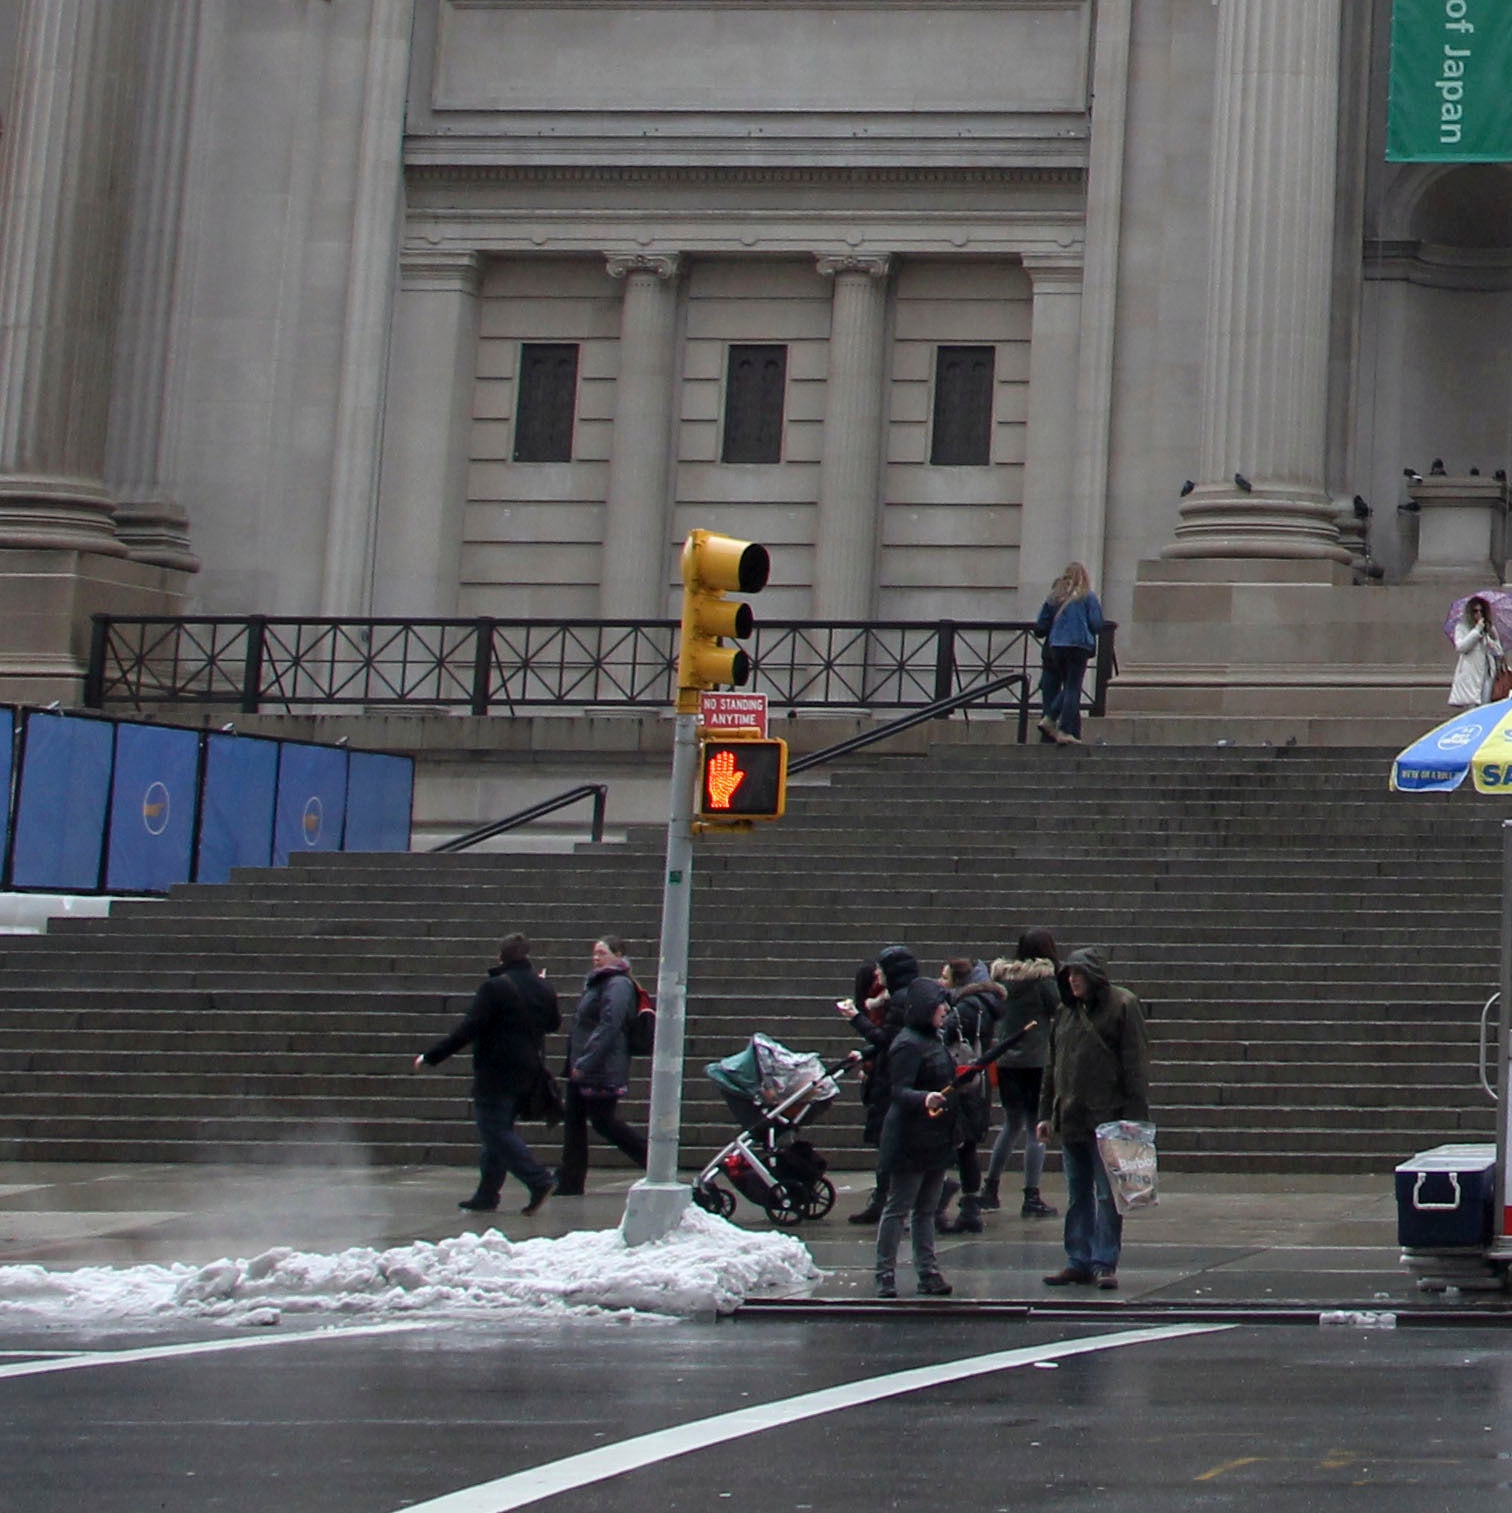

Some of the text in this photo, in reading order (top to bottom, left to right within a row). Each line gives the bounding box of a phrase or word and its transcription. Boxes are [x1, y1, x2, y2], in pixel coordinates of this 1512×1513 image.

[1435, 44, 1471, 145] Japan
[704, 698, 763, 711] NO STANDING
[711, 713, 757, 726] ANYTIME
